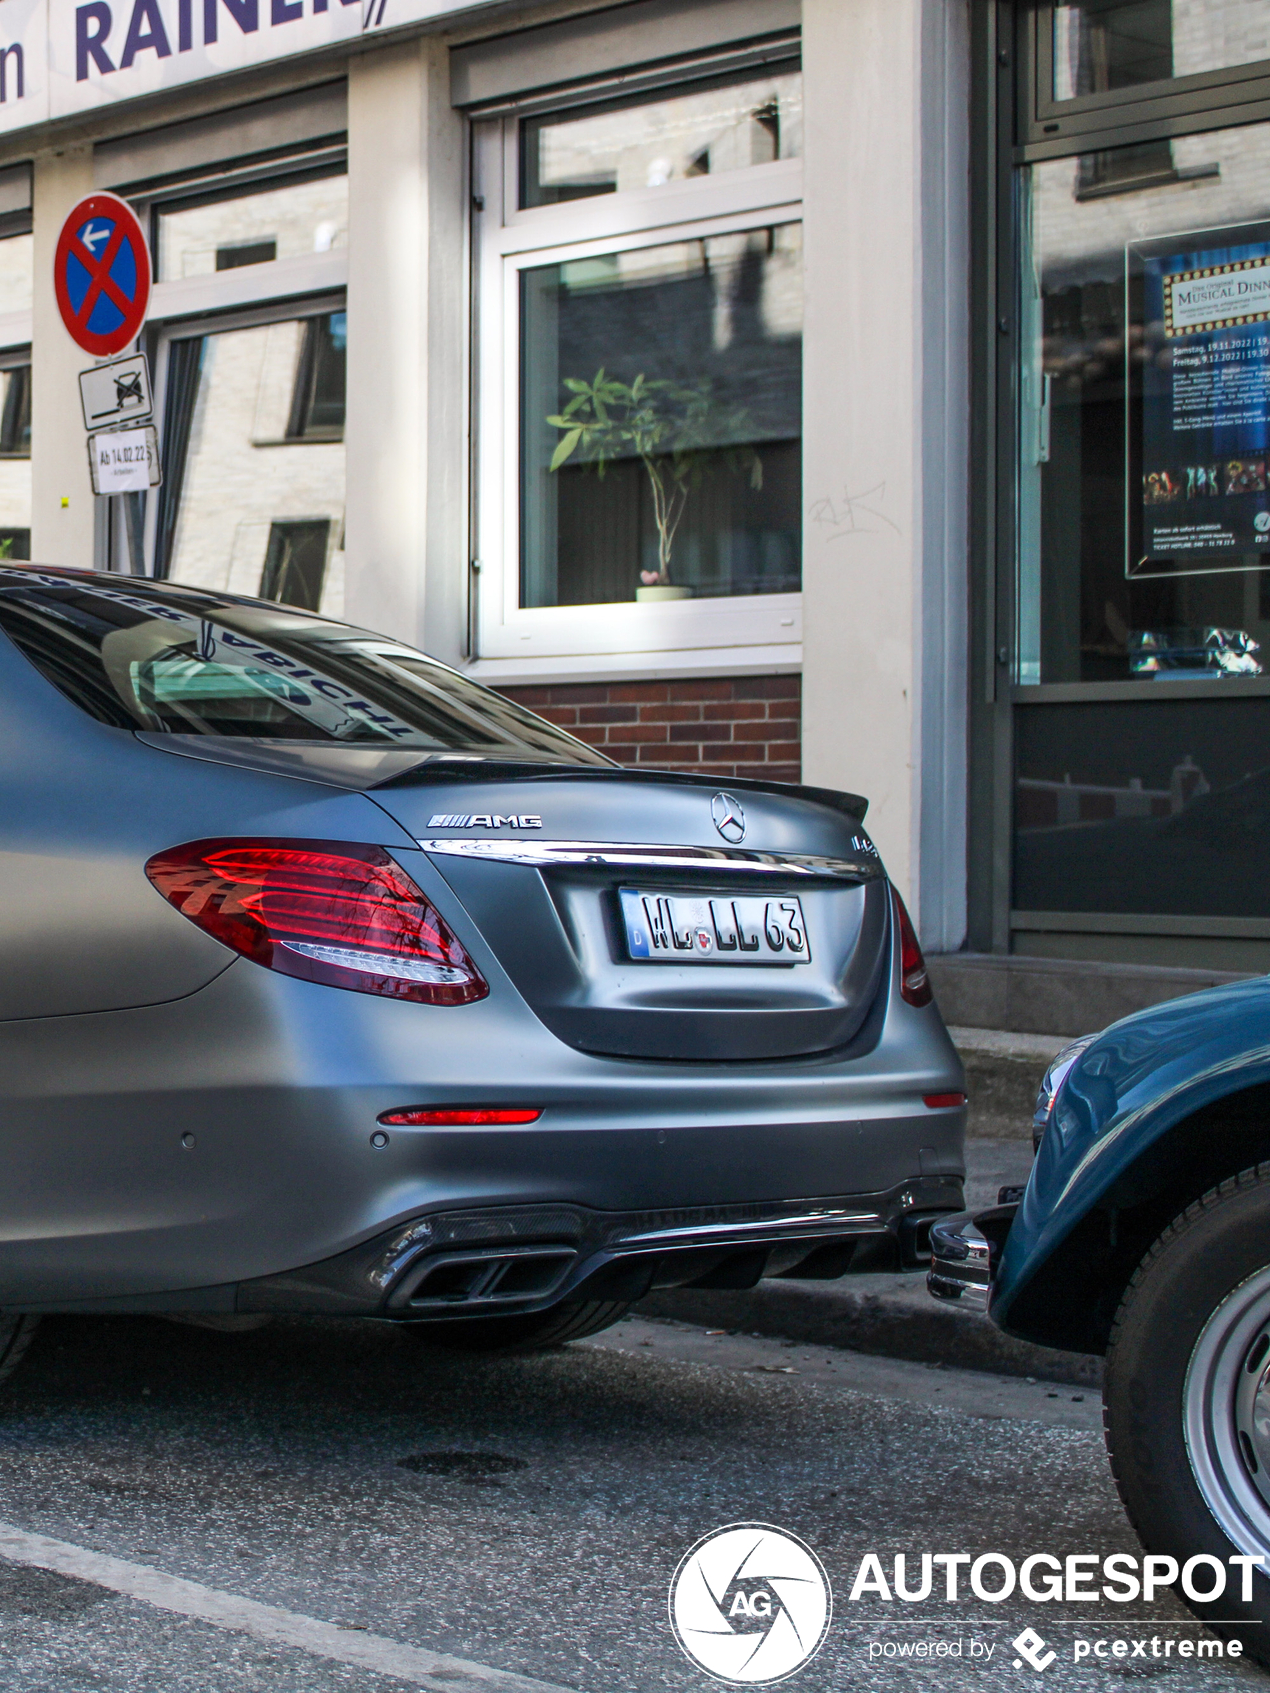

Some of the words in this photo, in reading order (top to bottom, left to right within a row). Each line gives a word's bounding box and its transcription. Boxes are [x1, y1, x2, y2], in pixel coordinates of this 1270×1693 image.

[76, 0, 361, 83] RAIN
[1206, 279, 1234, 291] Original
[1178, 287, 1235, 306] MUSICAL
[1173, 346, 1206, 356] Samstag,
[1208, 339, 1250, 352] 19.11.2022
[1173, 358, 1201, 368] Freitag,
[1202, 352, 1240, 364] 9.12.2022
[1247, 348, 1269, 359] 19.30
[100, 450, 110, 466] Ab
[112, 445, 145, 463] 14.02.22
[466, 814, 543, 829] AMG
[634, 930, 642, 946] D
[642, 896, 693, 950] WL
[708, 900, 760, 952] LL
[764, 902, 805, 953] 63
